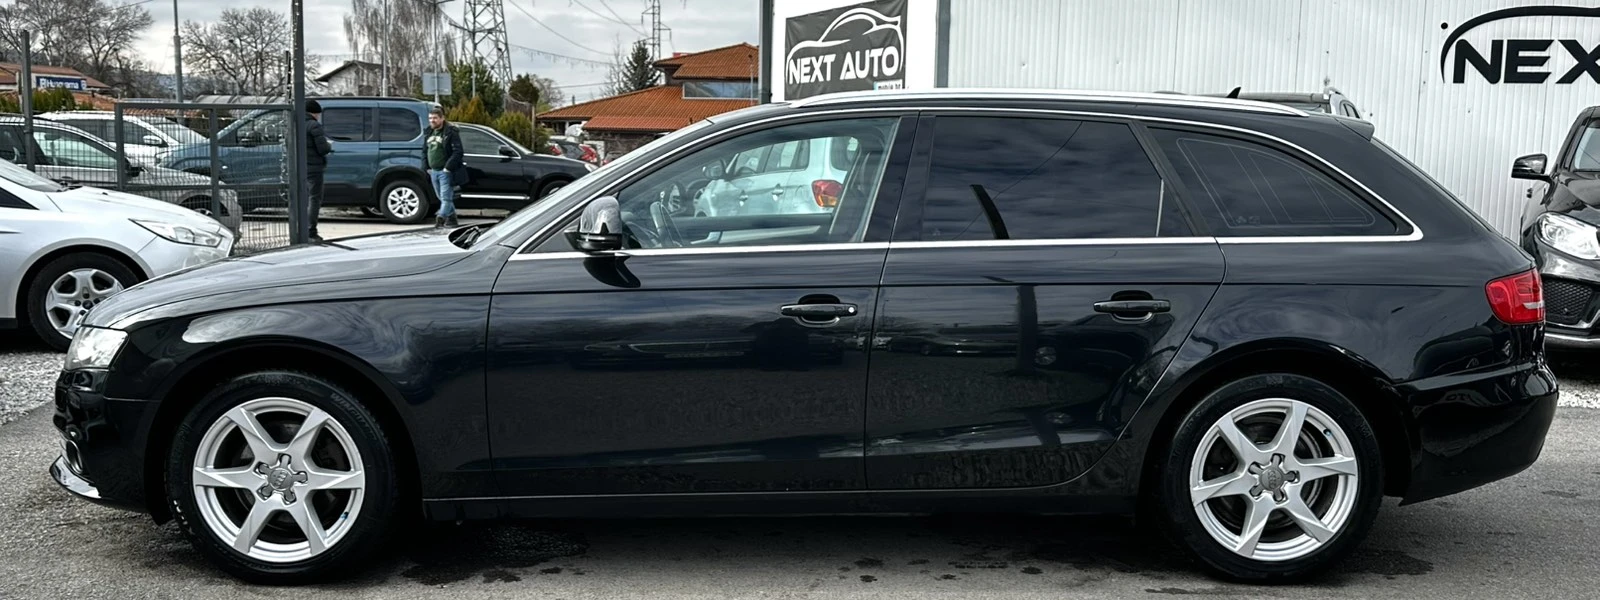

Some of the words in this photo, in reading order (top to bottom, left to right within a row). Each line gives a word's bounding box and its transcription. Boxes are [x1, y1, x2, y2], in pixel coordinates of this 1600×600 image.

[788, 54, 836, 84] NEXT
[840, 46, 899, 80] AUTO
[1453, 39, 1600, 84] NEX
[47, 80, 79, 89] Huqarna
